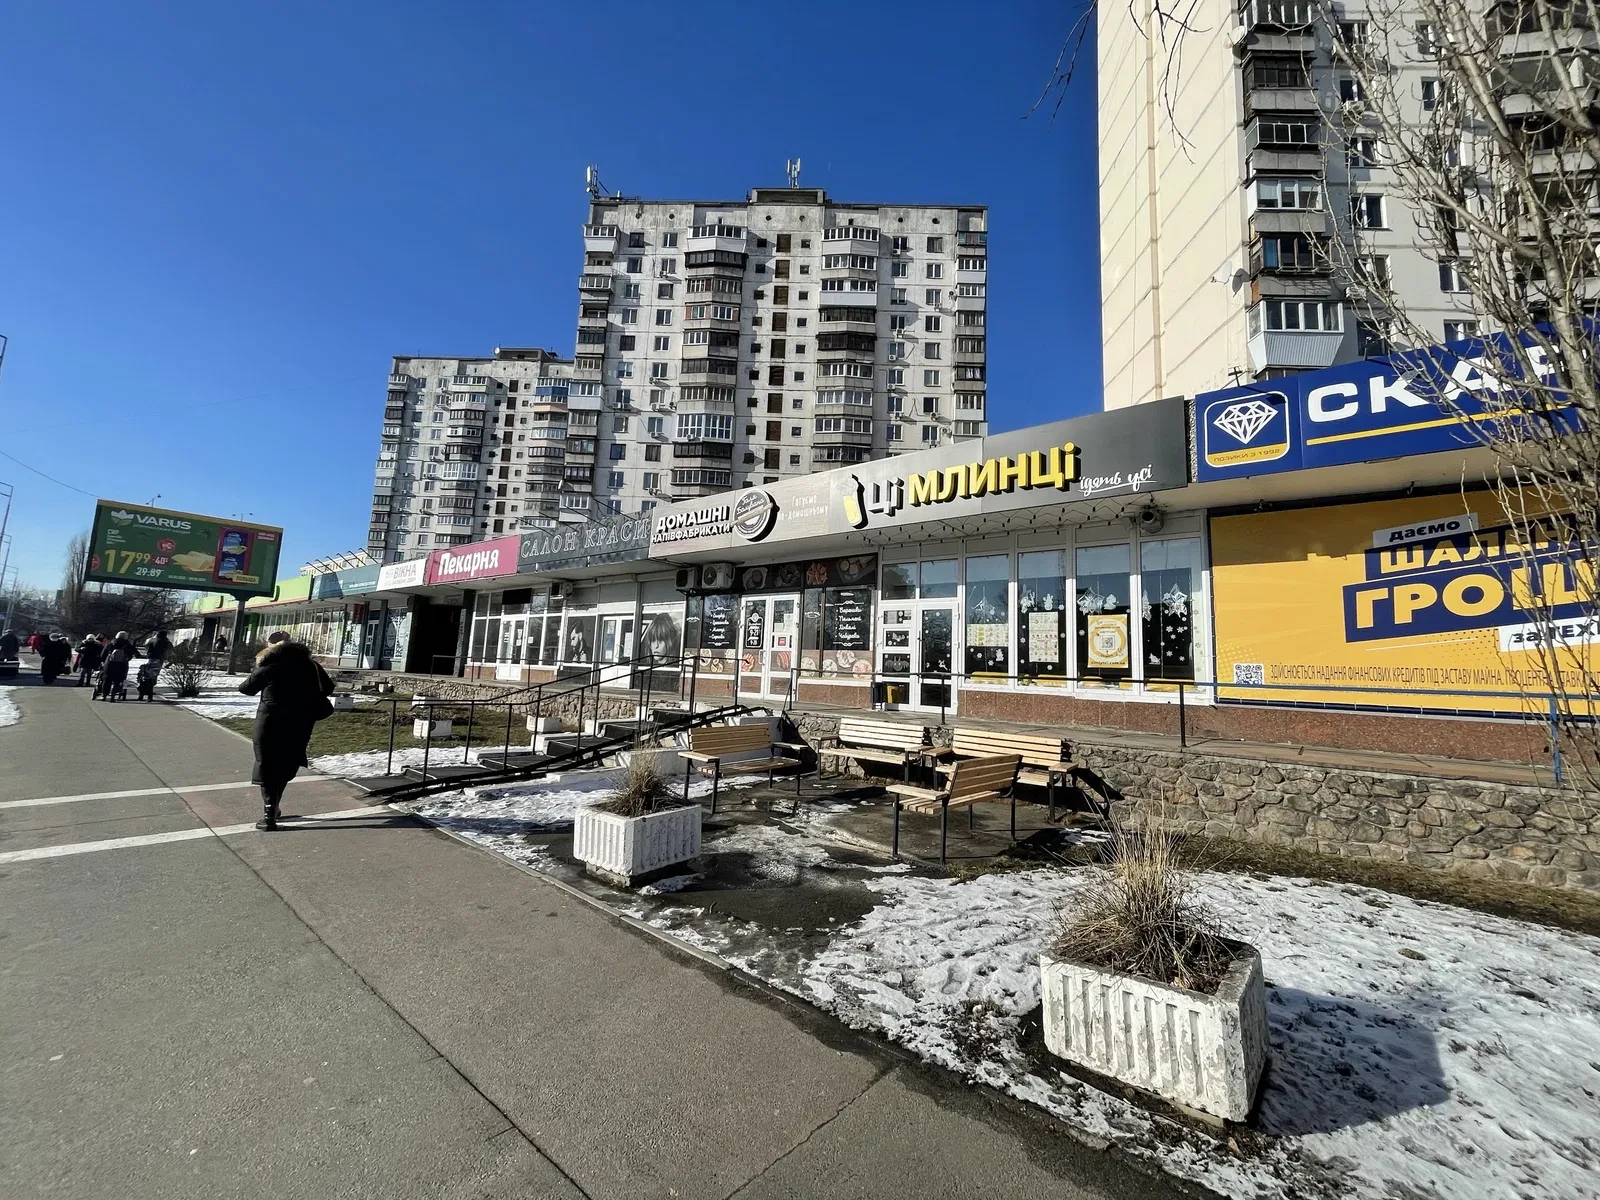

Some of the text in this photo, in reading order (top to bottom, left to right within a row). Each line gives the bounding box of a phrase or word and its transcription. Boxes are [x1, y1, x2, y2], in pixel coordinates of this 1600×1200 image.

[136, 514, 192, 530] VARUS
[657, 505, 728, 532] ДОМАШНІ
[521, 518, 649, 558] САЛОН КРАСИ
[651, 523, 731, 543] НАПІВФАБРИКАТИ
[1389, 520, 1460, 542] даємо
[104, 549, 136, 574] 17
[136, 552, 151, 564] 99
[393, 564, 417, 579] ВІКНА
[438, 549, 499, 576] Пекарня
[1317, 665, 1347, 683] НАДАННЯ
[1348, 665, 1391, 682] ФІНАНСОВИХ
[1392, 667, 1425, 685] КРЕДИТІВ
[1426, 667, 1439, 687] ПІД
[1440, 668, 1472, 685] ЗАСТАВУ
